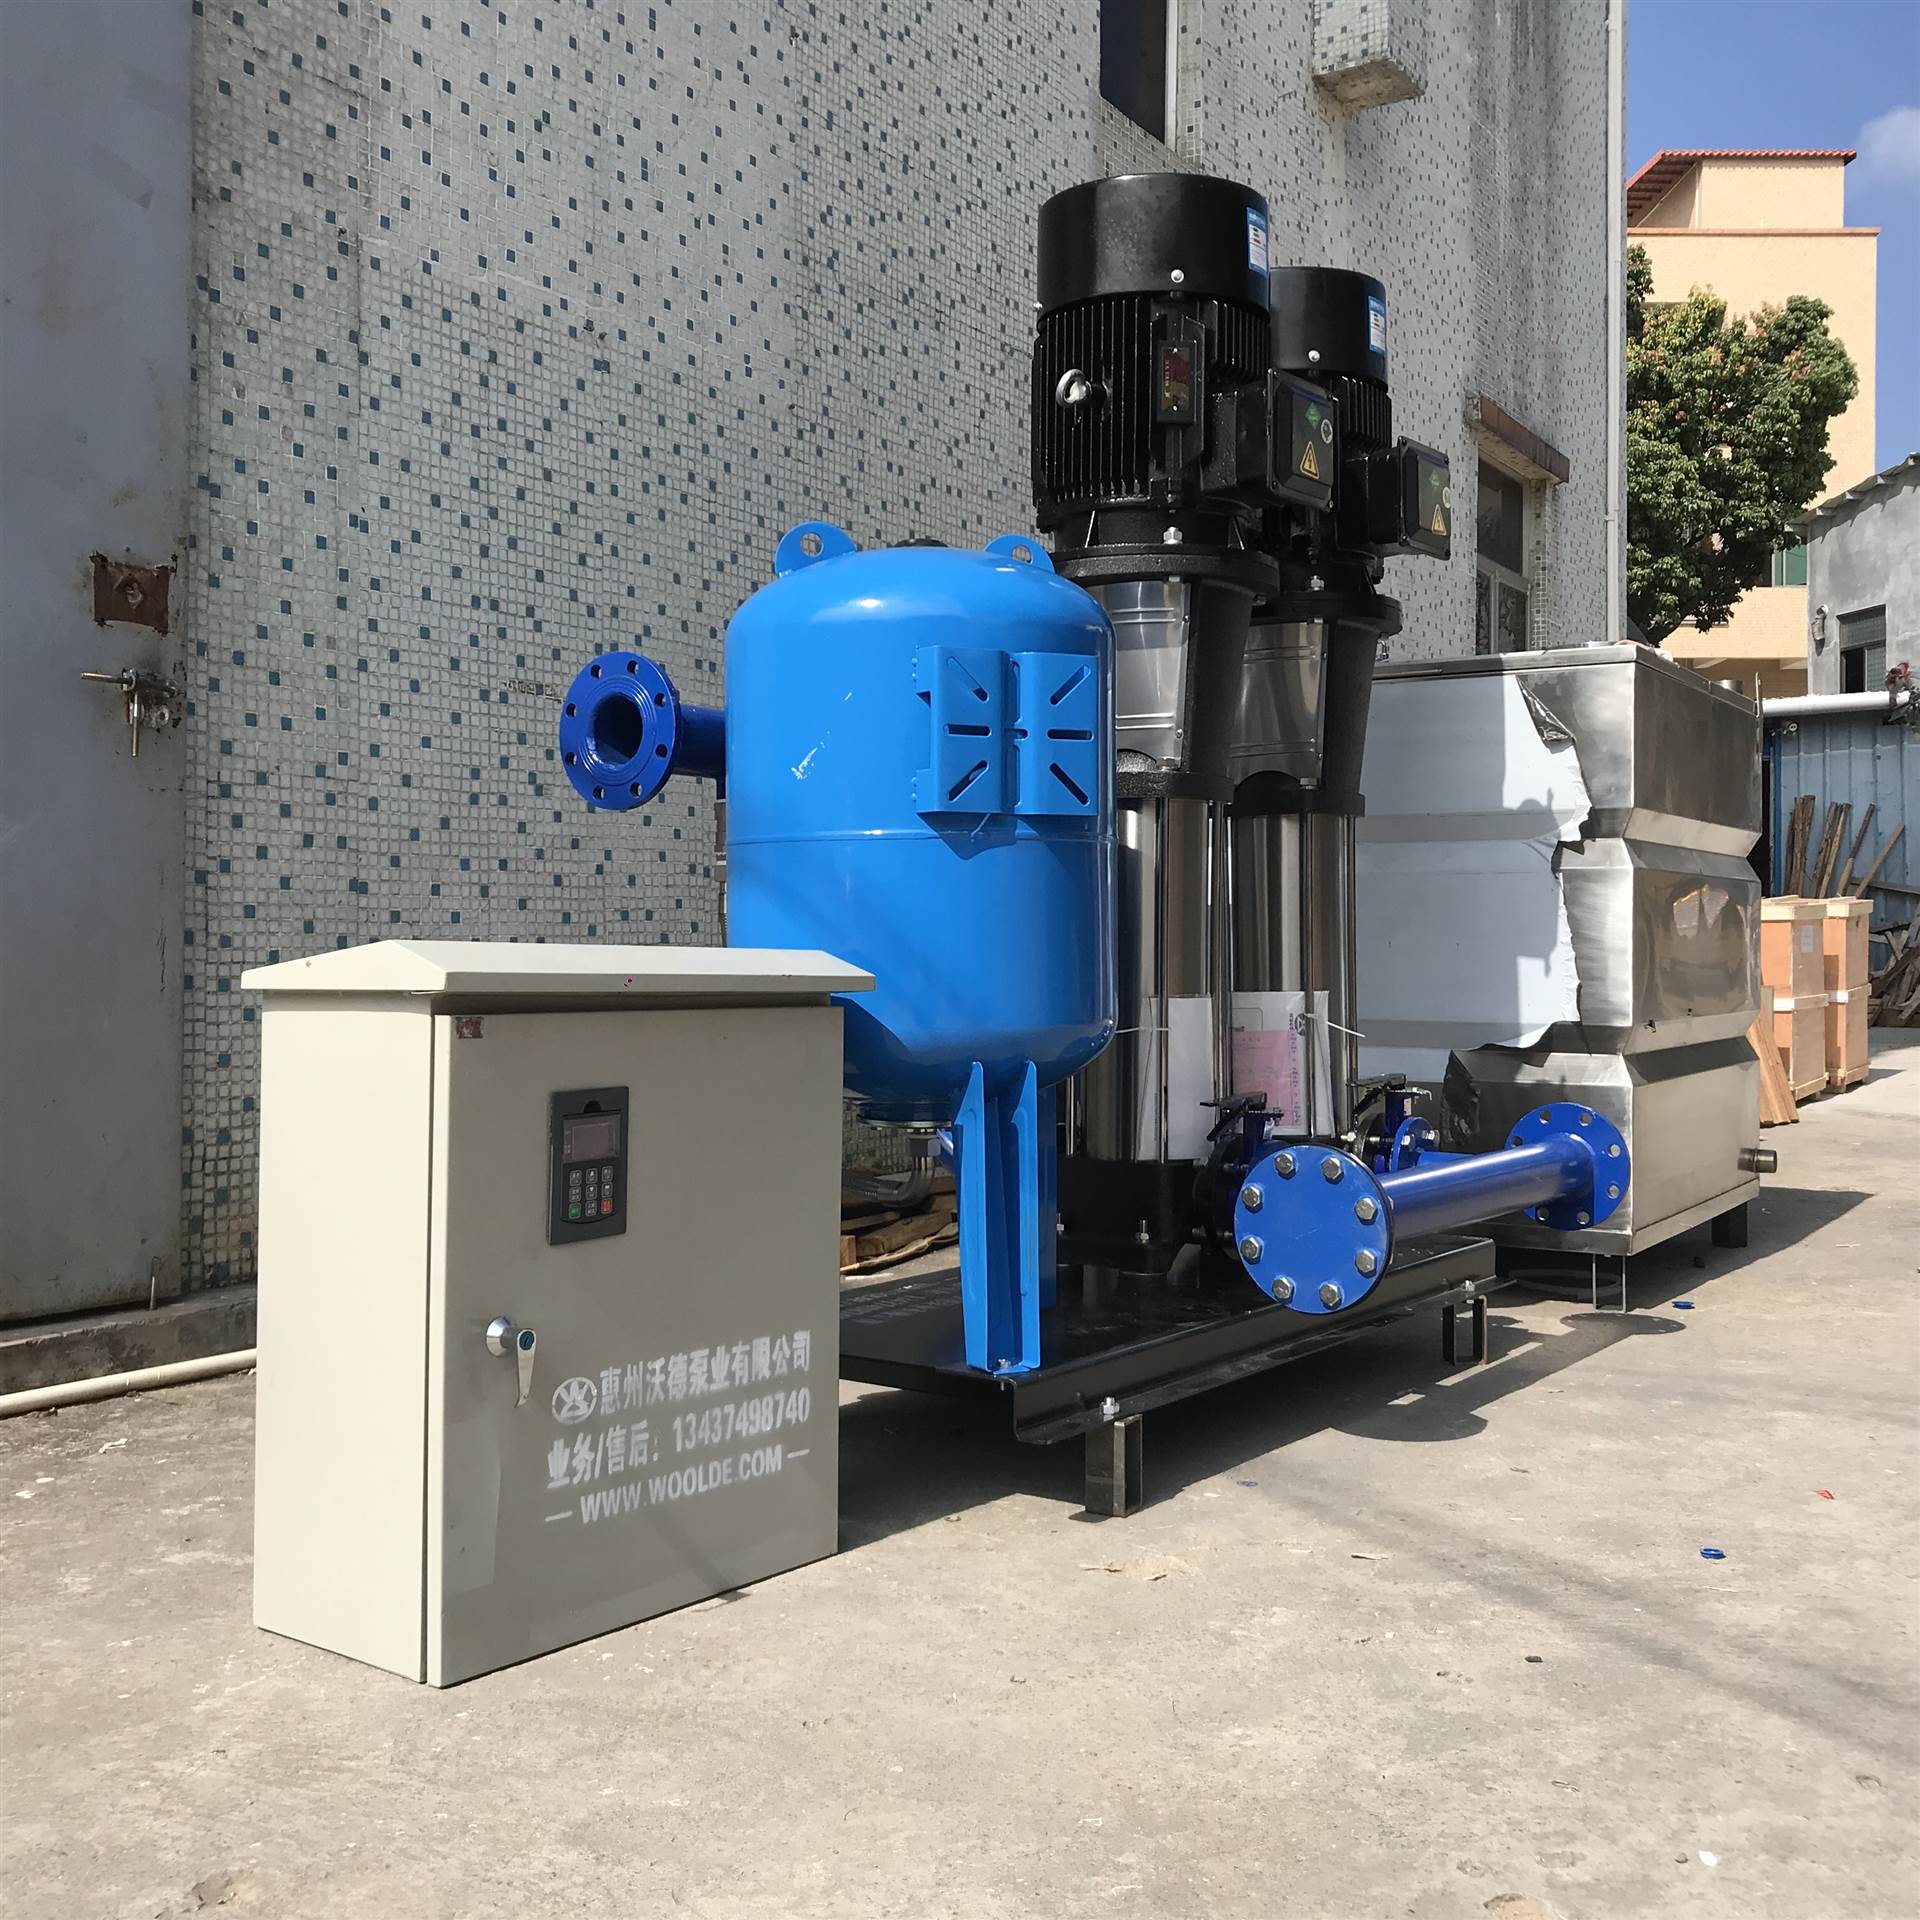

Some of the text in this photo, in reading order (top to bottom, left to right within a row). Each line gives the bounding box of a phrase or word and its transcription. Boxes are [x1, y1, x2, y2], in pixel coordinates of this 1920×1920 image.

[600, 1330, 810, 1416] 惠州沃德泵业有限公司
[672, 1387, 810, 1452] 13437498740
[580, 1445, 782, 1524] WWW.WOOLDE.COM
